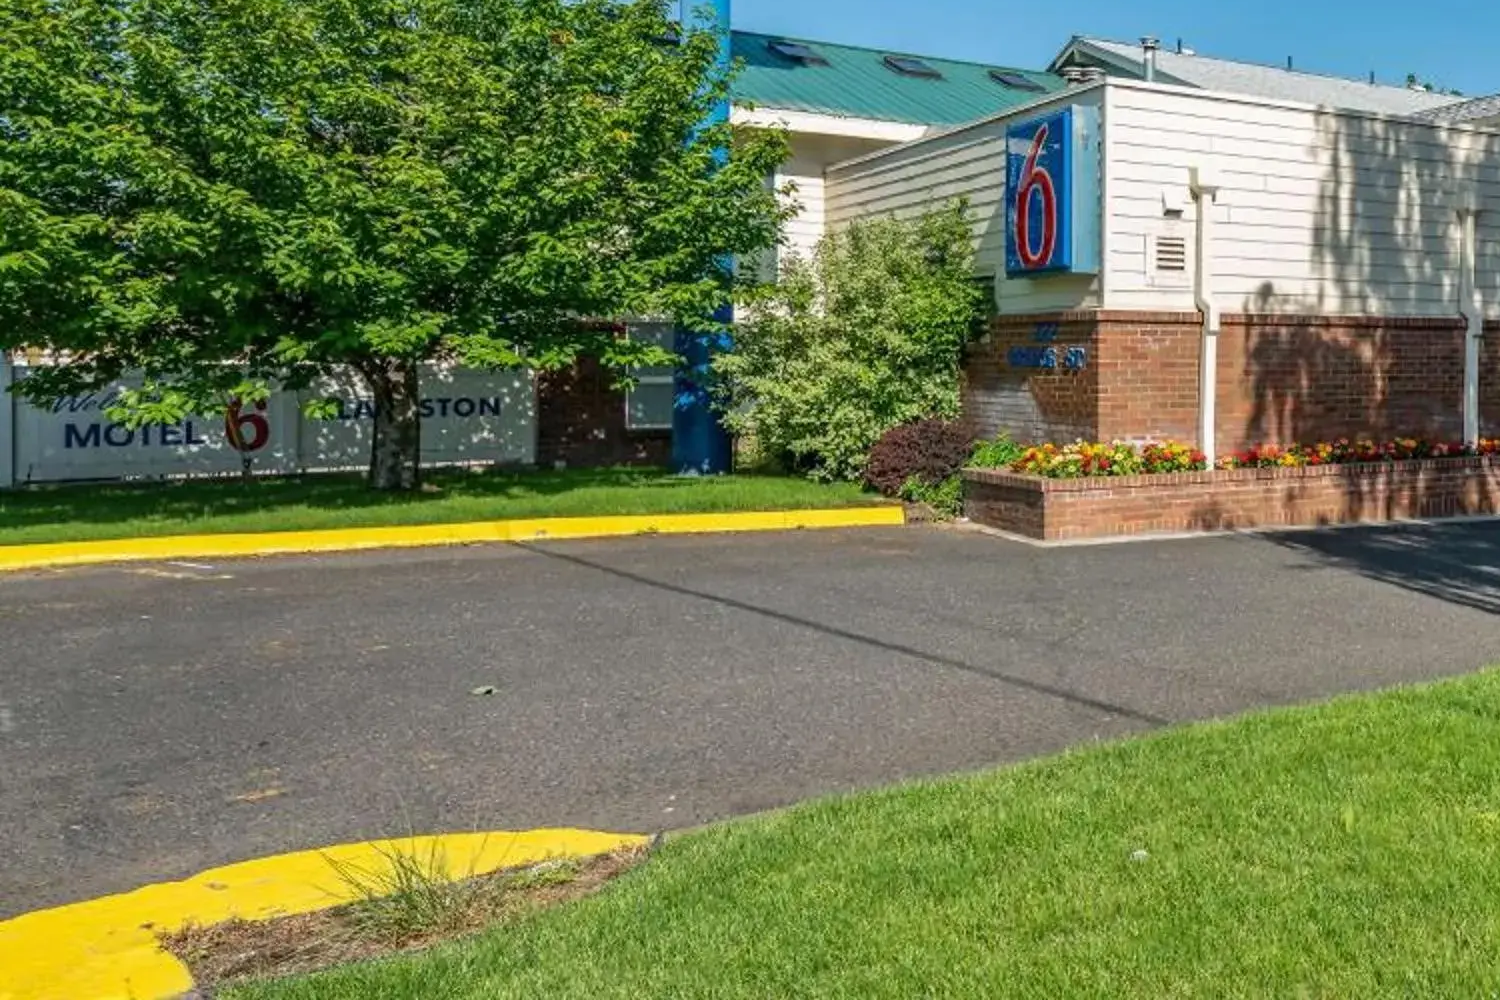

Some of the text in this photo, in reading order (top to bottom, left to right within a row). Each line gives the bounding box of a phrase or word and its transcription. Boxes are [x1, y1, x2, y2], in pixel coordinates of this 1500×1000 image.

[1014, 122, 1057, 270] 6
[64, 421, 206, 449] MOTEL
[225, 396, 269, 452] 6
